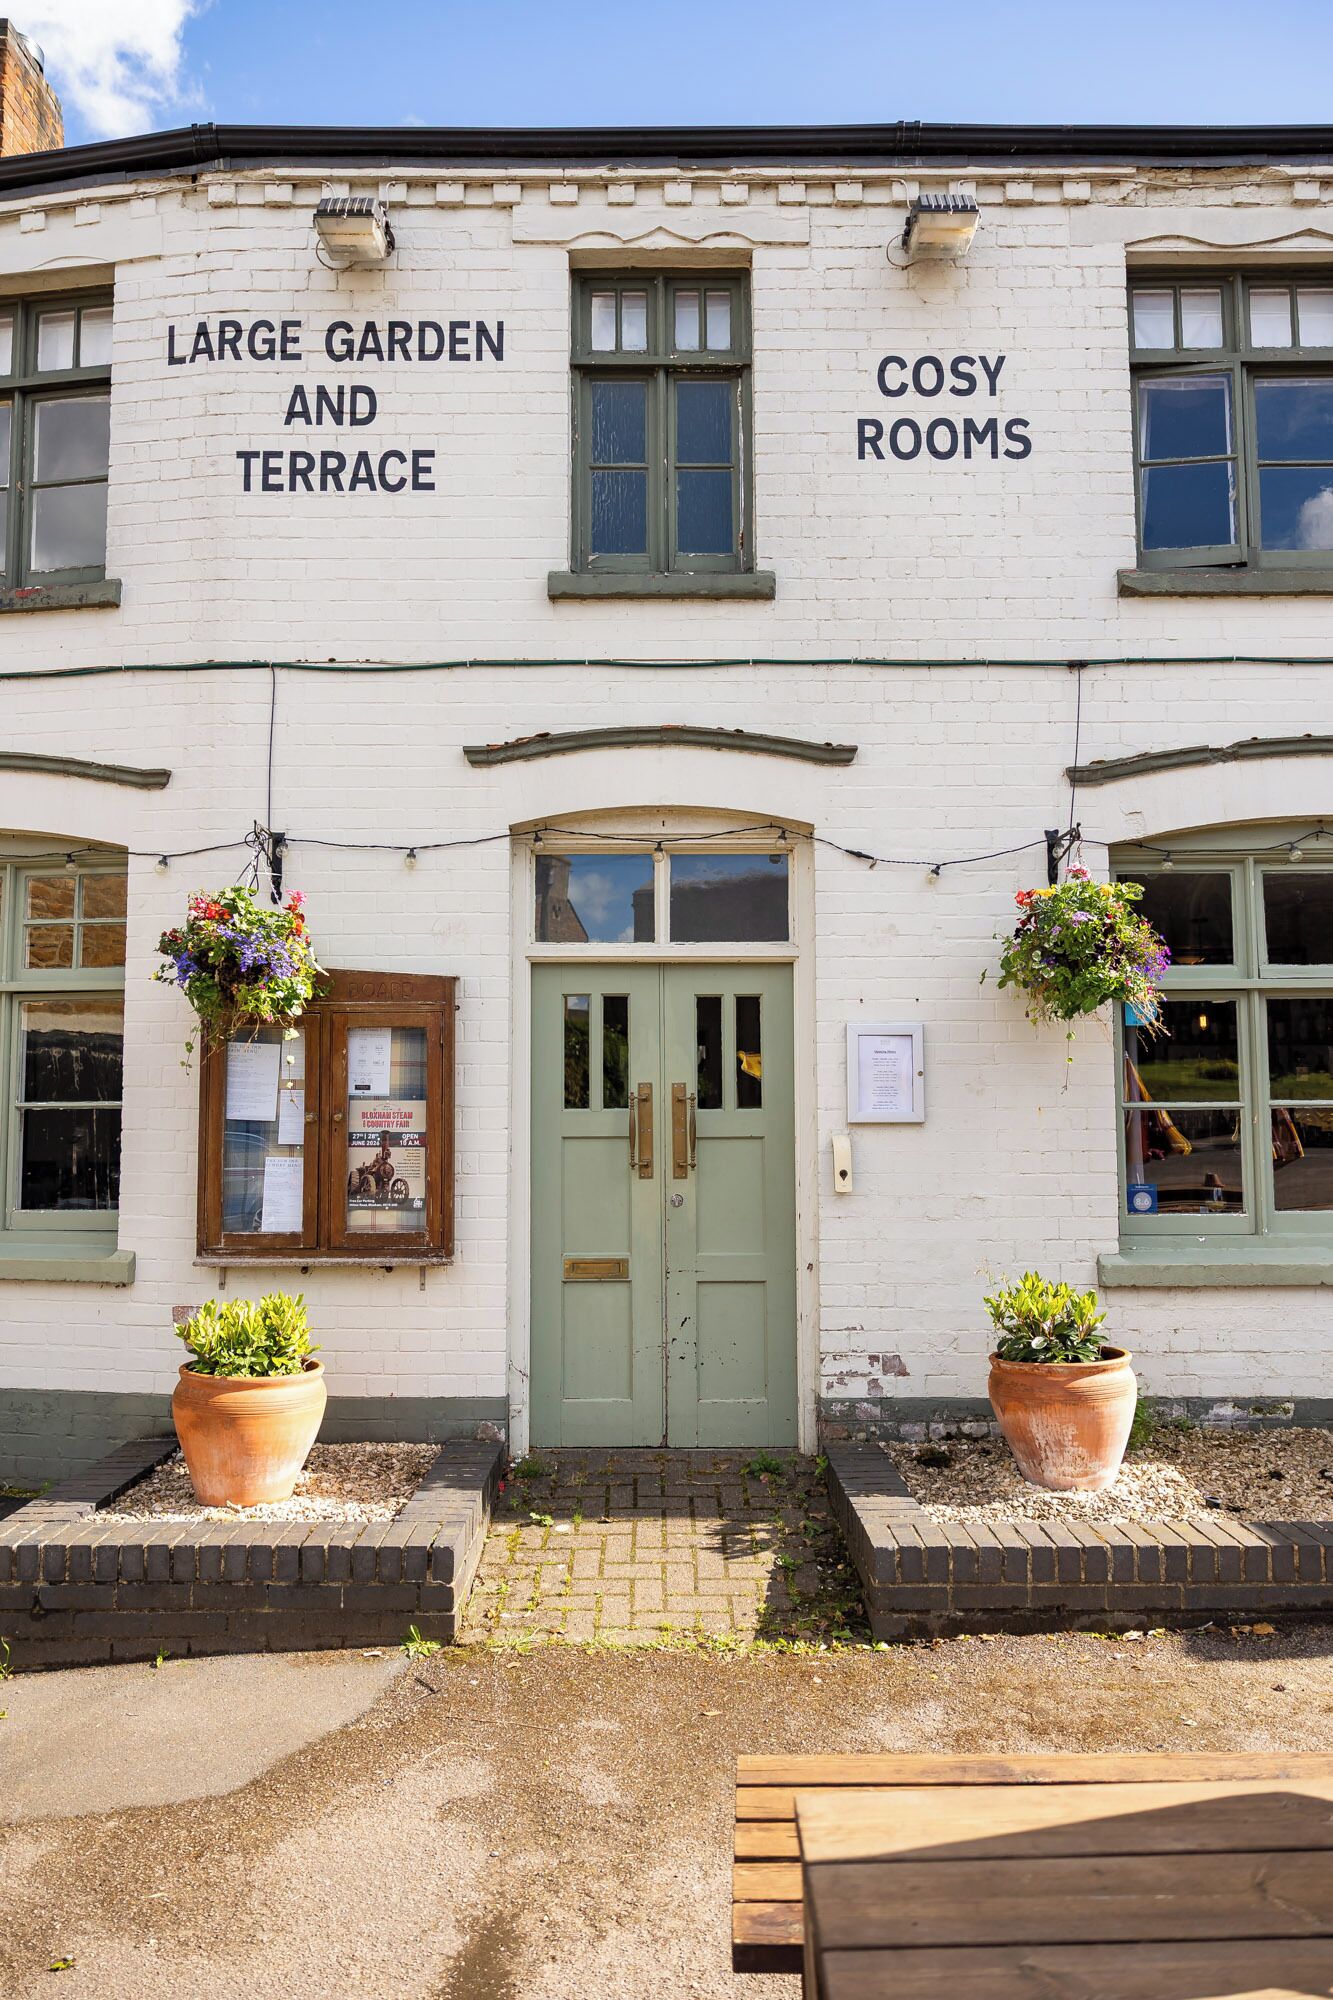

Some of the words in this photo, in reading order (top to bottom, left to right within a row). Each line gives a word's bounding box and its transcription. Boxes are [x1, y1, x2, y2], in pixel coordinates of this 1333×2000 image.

[167, 319, 302, 366] LARGE
[324, 320, 504, 363] GARDEN
[877, 355, 1006, 398] COSY
[284, 384, 377, 427] AND
[857, 417, 1032, 461] ROOMS
[236, 449, 436, 493] TERRACE
[361, 1111, 392, 1120] BLOXHAM
[392, 1111, 413, 1120] STEAM
[366, 1120, 395, 1128] COUNTRY
[395, 1120, 410, 1128] FAIR
